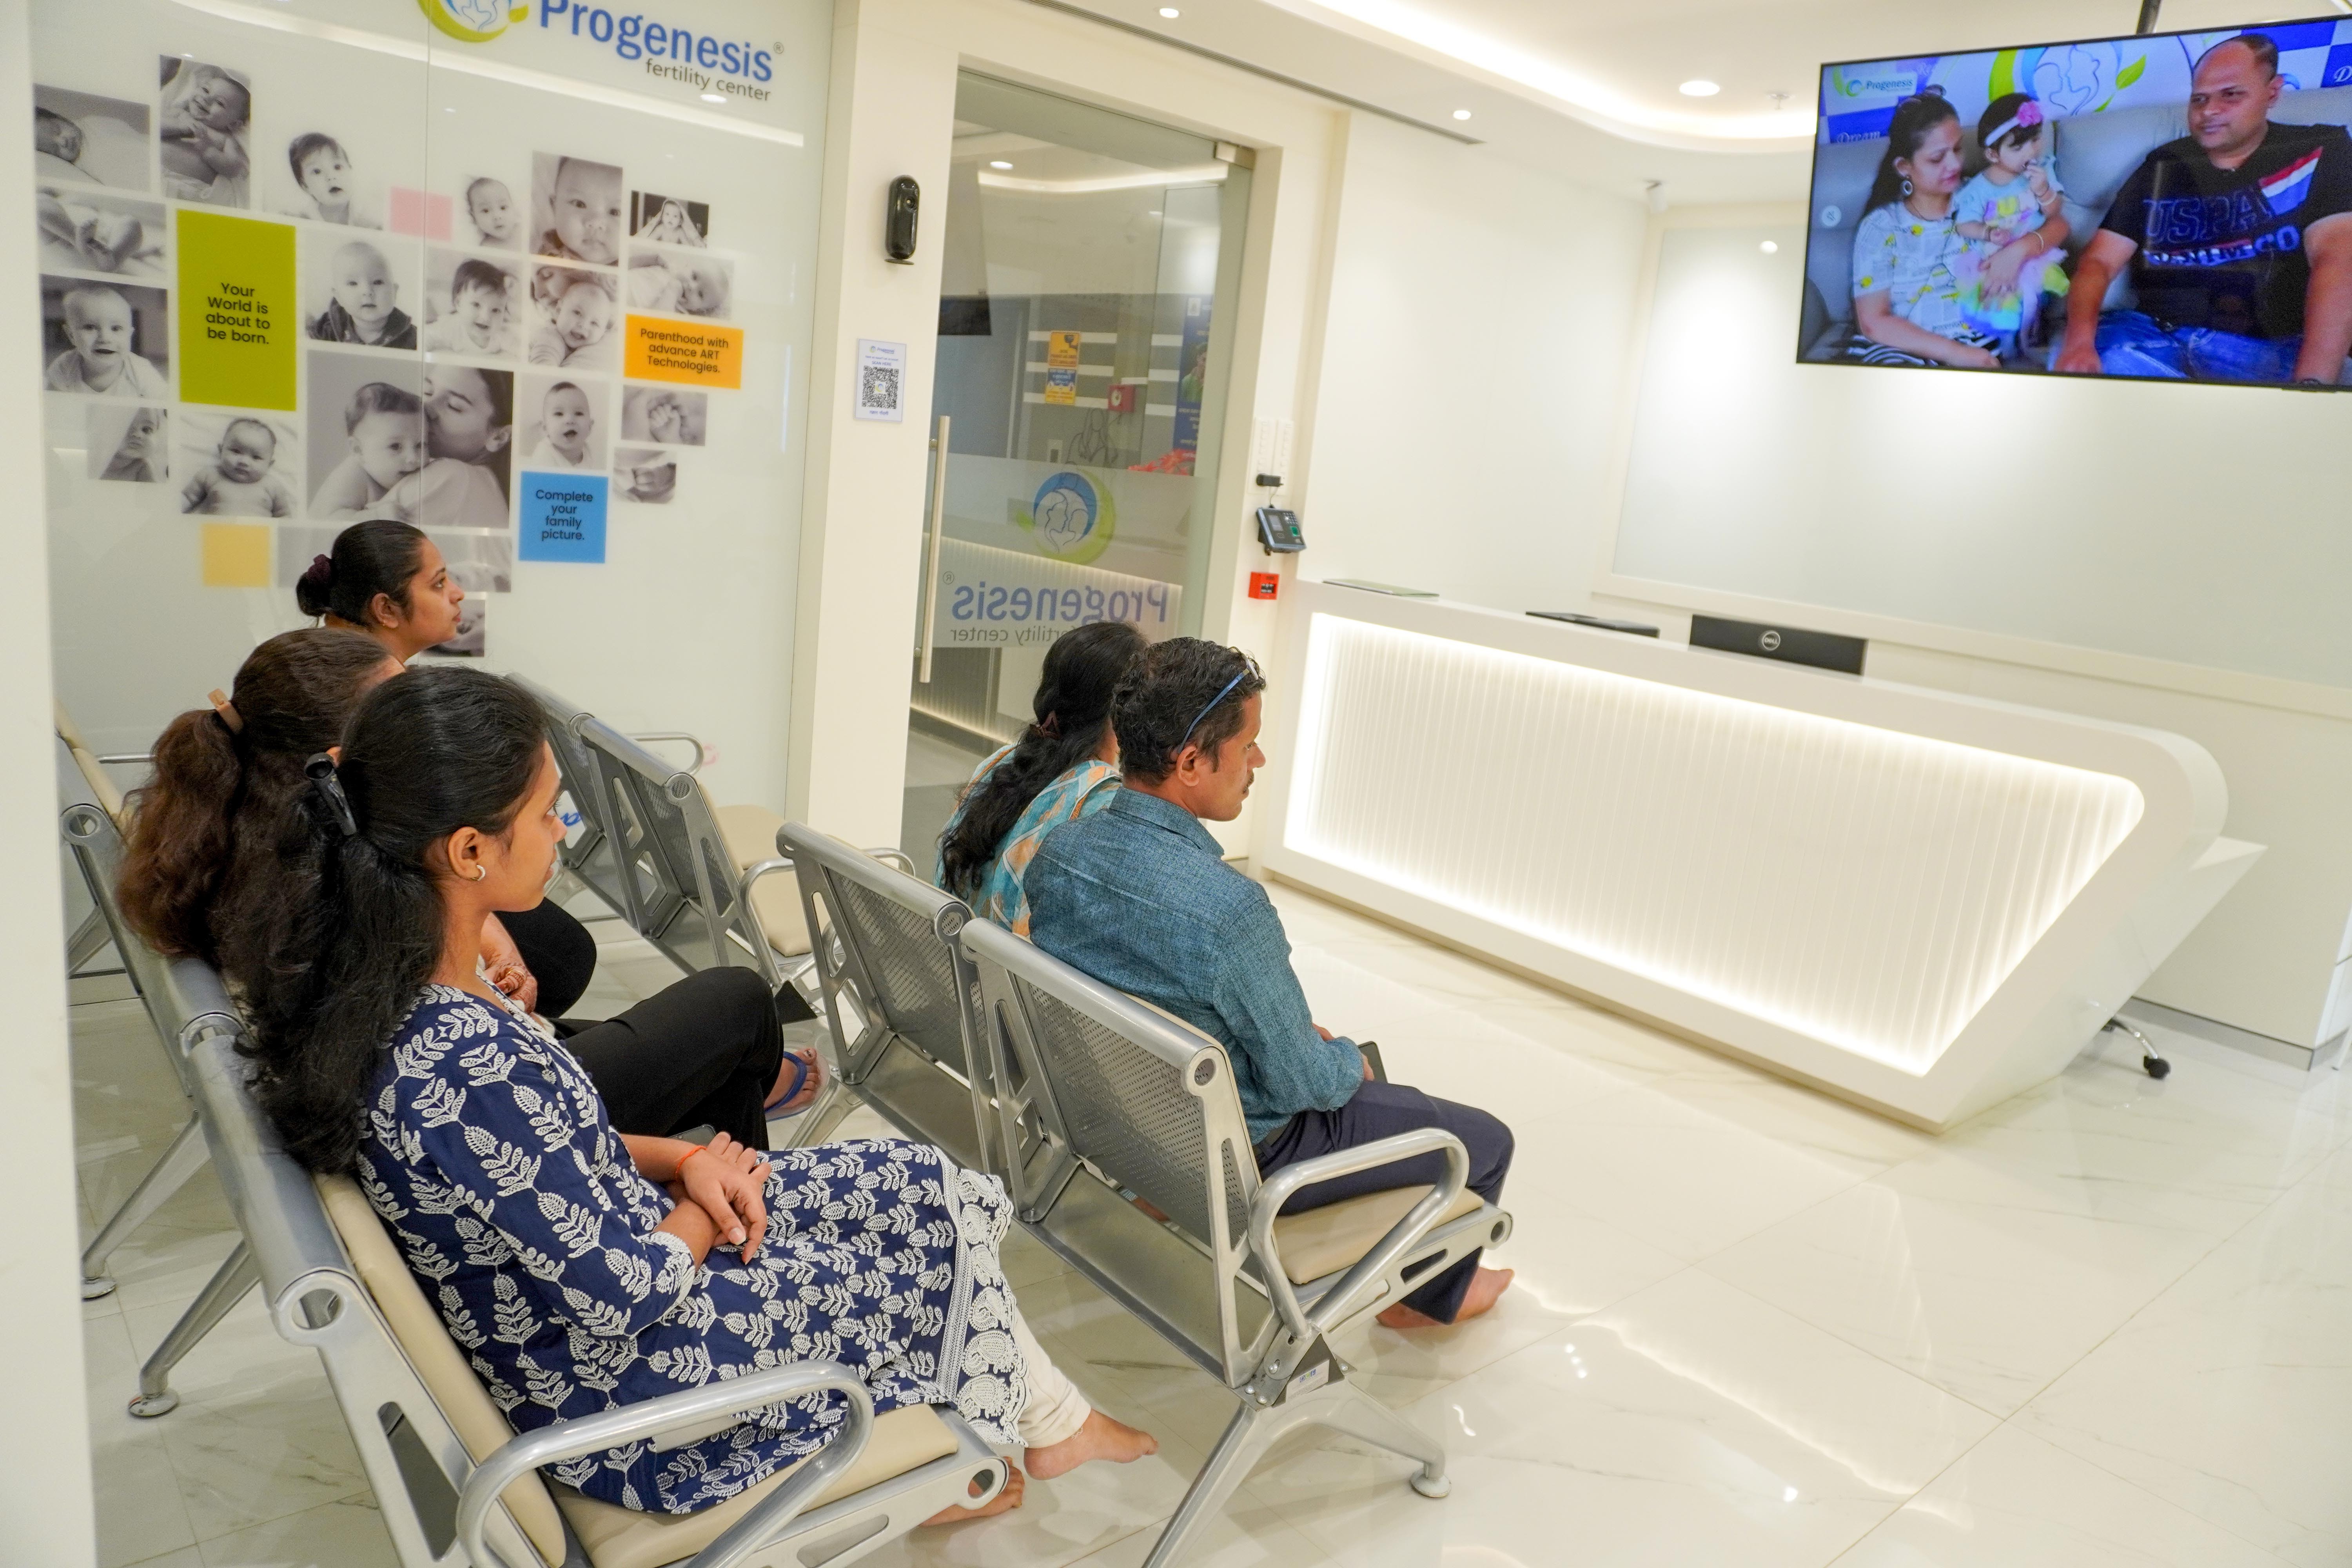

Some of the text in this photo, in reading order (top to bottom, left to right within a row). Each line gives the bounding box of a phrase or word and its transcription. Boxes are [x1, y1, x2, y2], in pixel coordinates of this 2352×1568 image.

[646, 58, 771, 101] fertility center
[1866, 79, 1913, 91] Progenesis
[221, 282, 255, 297] Your
[207, 296, 268, 314] World is
[206, 312, 270, 329] about to
[208, 327, 269, 344] be born.
[641, 328, 728, 348] Parenthood with
[649, 343, 720, 360] advance ART
[648, 355, 720, 374] Technologies.
[536, 490, 593, 503] Complete
[552, 505, 577, 515] your
[545, 515, 582, 530] family
[541, 528, 584, 542] picture.
